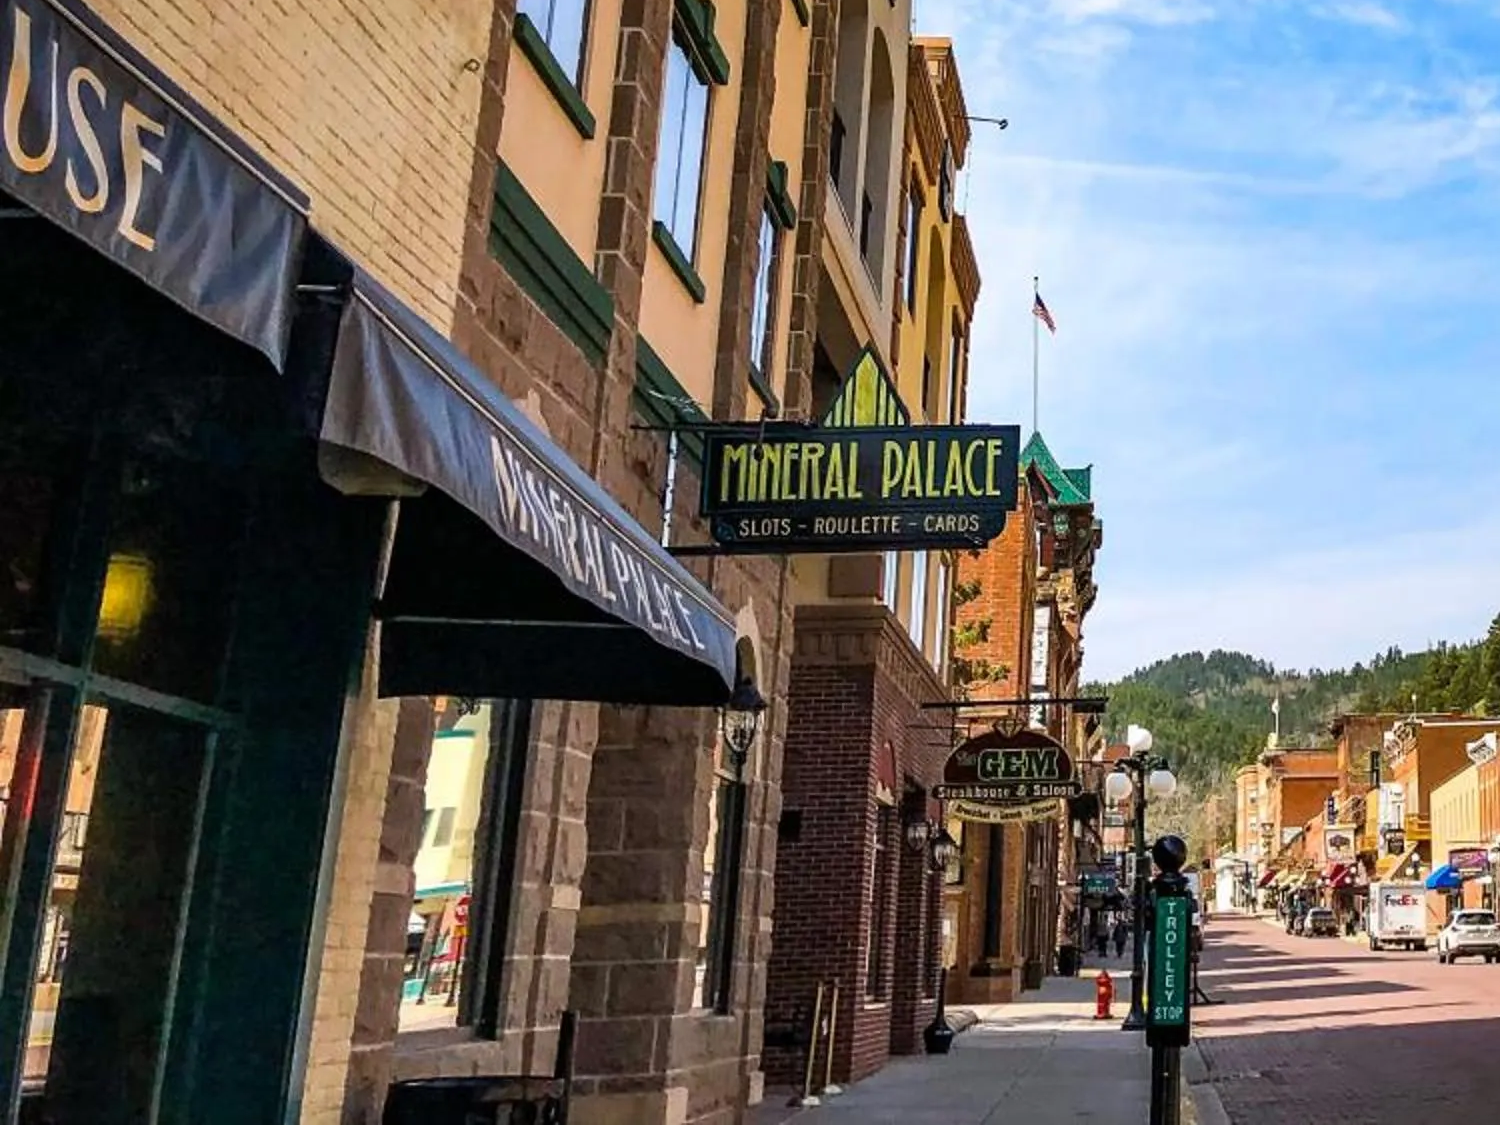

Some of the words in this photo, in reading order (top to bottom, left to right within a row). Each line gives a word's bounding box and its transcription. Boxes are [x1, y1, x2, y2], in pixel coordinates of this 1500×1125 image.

[720, 441, 863, 502] MINERAL
[881, 438, 1002, 500] PALACE
[738, 518, 791, 537] SLOTS
[814, 515, 901, 535] ROULETTE
[924, 514, 980, 533] CARDS
[490, 435, 617, 602] MINERAL
[610, 541, 705, 650] PALACE
[978, 748, 1059, 781] GEM
[1033, 784, 1075, 796] Saloon
[1385, 894, 1419, 907] FedEx
[1165, 902, 1178, 1002] TROLLEY
[1154, 1006, 1183, 1020] STOP
